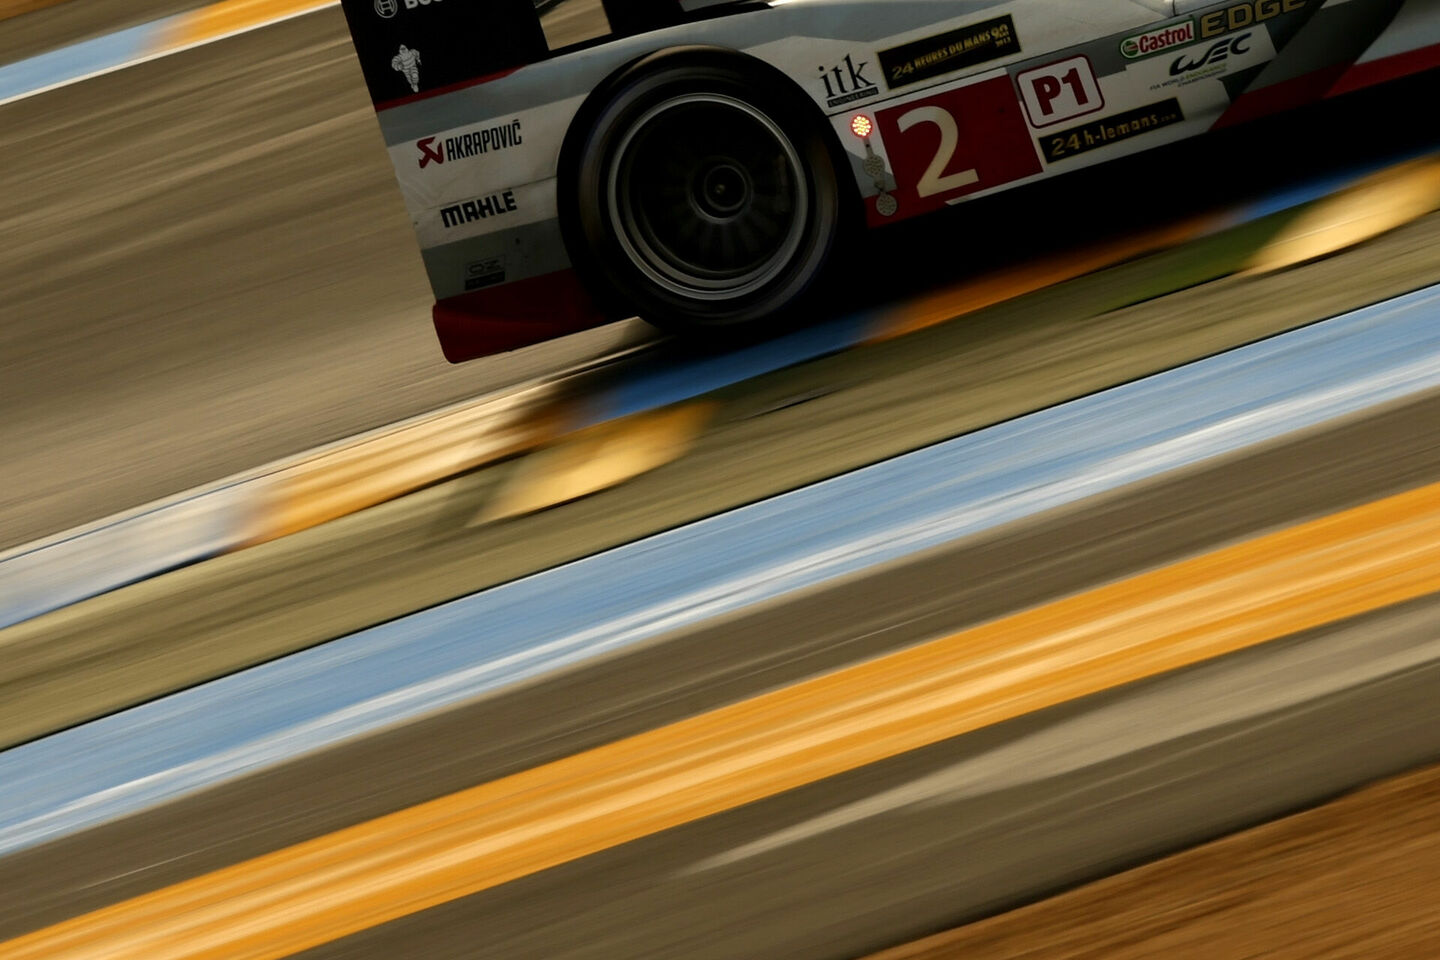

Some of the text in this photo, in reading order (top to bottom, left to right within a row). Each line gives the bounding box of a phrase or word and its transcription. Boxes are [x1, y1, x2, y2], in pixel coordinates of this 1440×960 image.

[890, 63, 916, 81] 24
[965, 29, 991, 50] MANS
[1139, 22, 1194, 54] Castrol
[818, 53, 877, 99] itk
[1031, 67, 1089, 117] P1
[896, 104, 981, 199] 2
[440, 190, 518, 228] MAHLE
